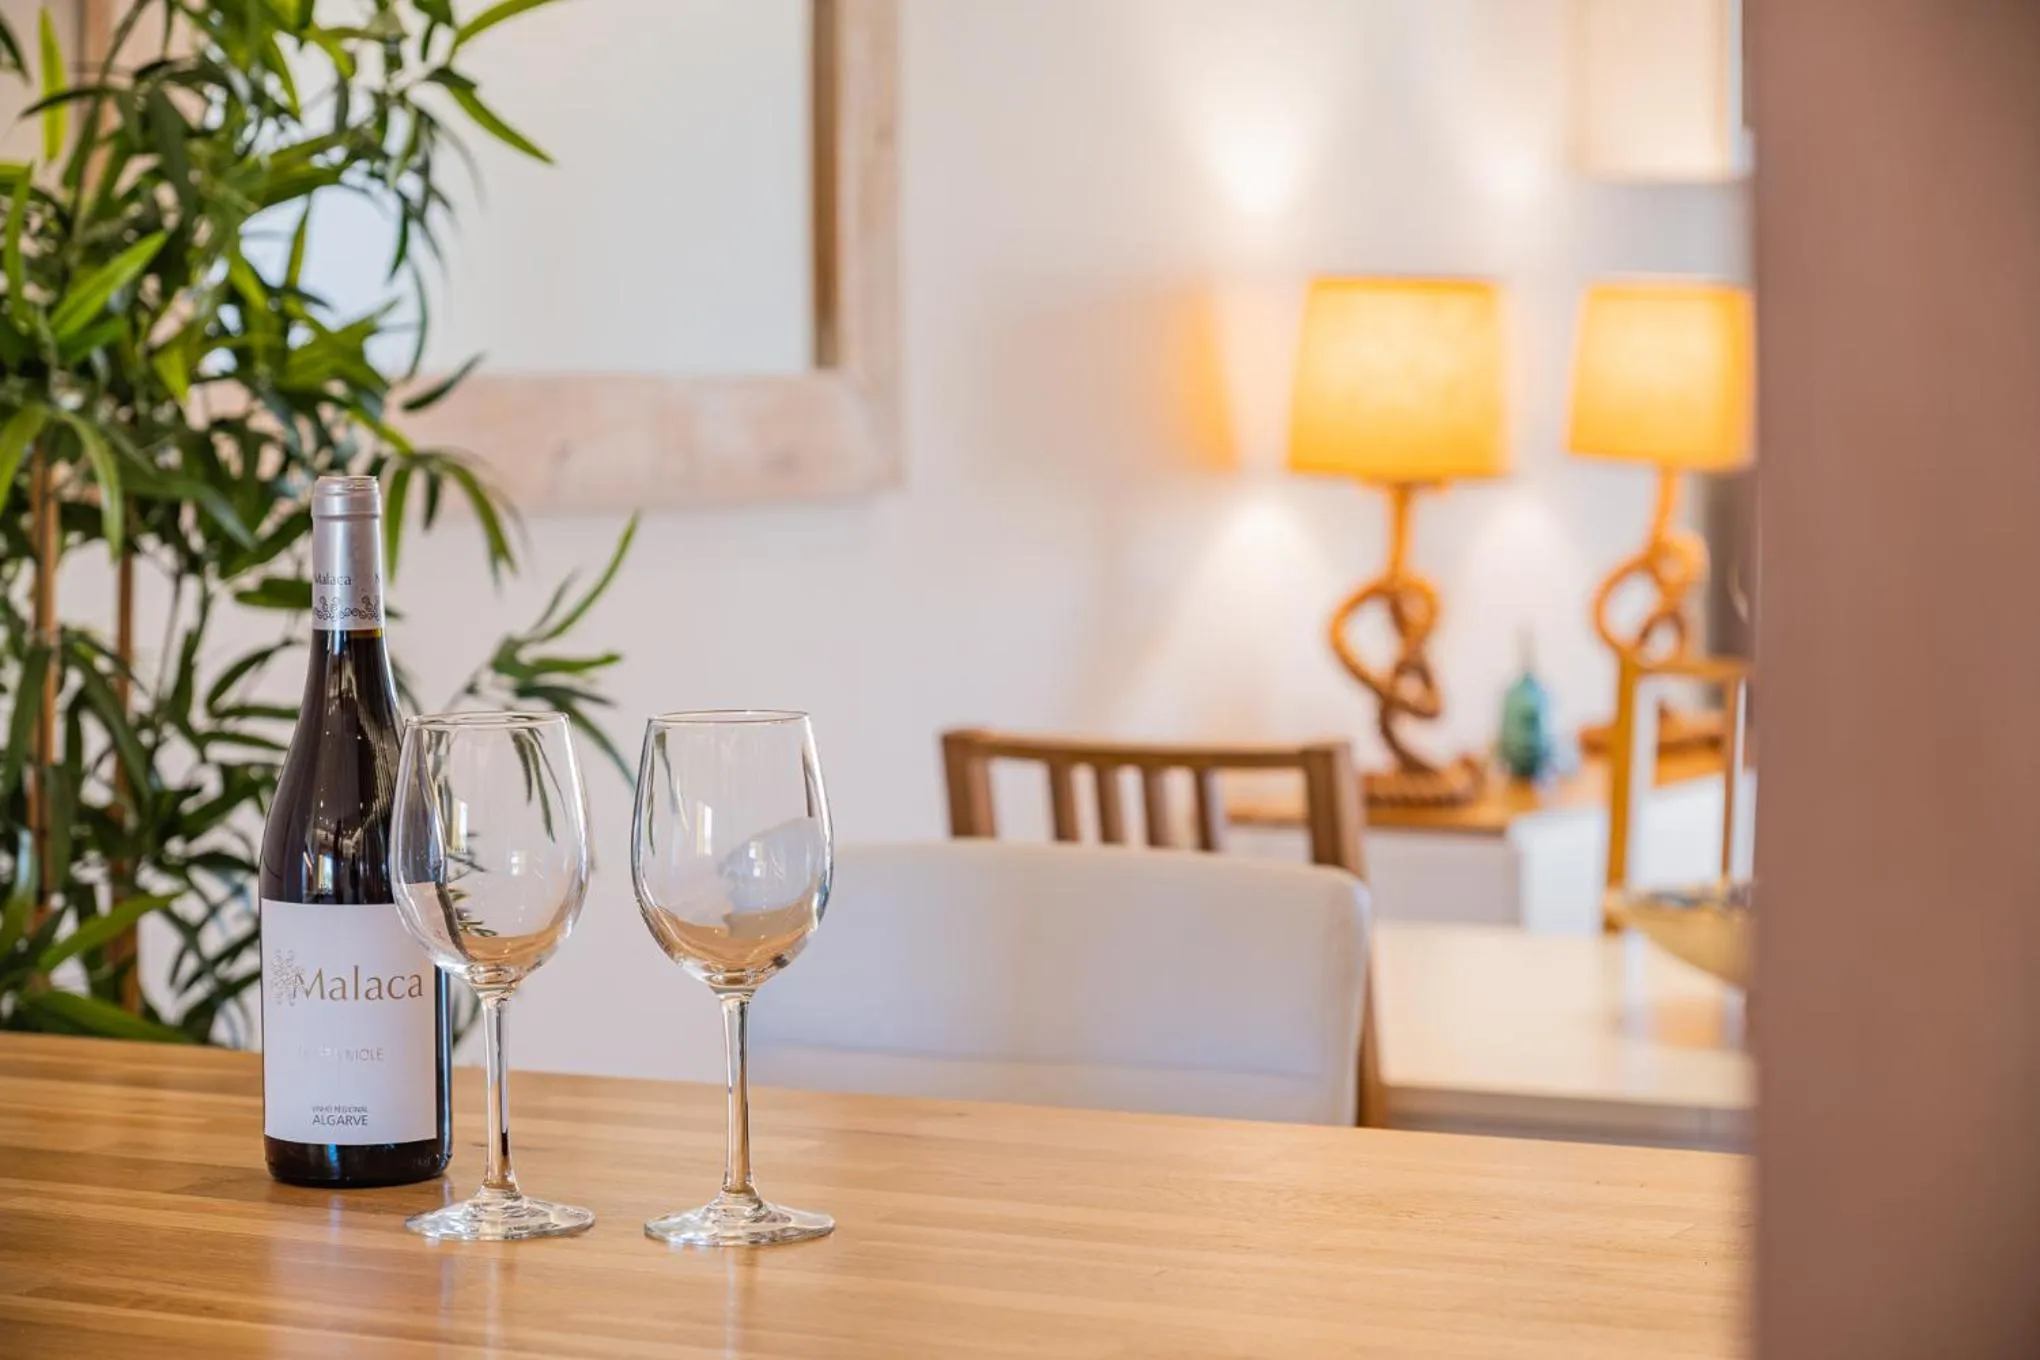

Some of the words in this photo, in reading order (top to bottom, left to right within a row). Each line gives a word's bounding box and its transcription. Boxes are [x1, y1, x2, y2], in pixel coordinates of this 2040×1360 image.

[314, 572, 352, 586] Malaca
[292, 964, 424, 1001] Malaca
[312, 1114, 369, 1126] ALGARVE
